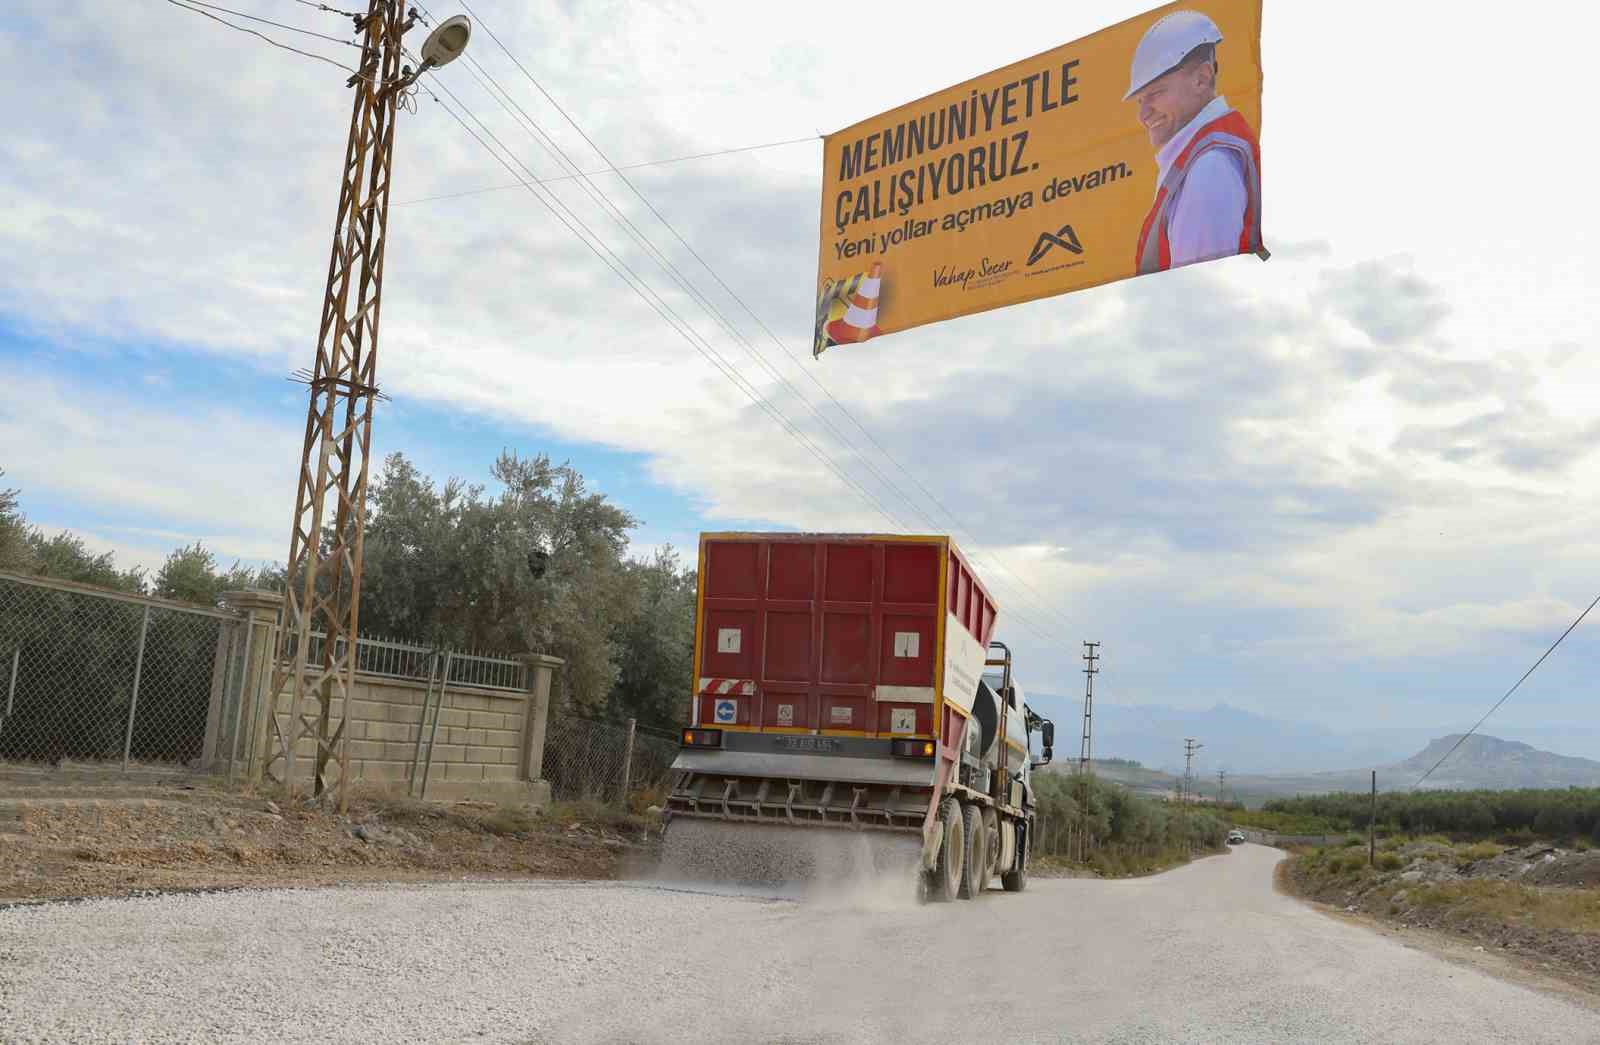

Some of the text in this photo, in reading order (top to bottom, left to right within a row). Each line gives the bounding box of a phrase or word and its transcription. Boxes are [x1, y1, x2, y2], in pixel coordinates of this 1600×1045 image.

[839, 59, 1080, 181] MEMNUNİYETLE
[834, 161, 1132, 260] Yeni yollar açmaya devam.
[835, 130, 1039, 235] ÇALIŞIYORUZ.
[933, 265, 975, 291] Vahap
